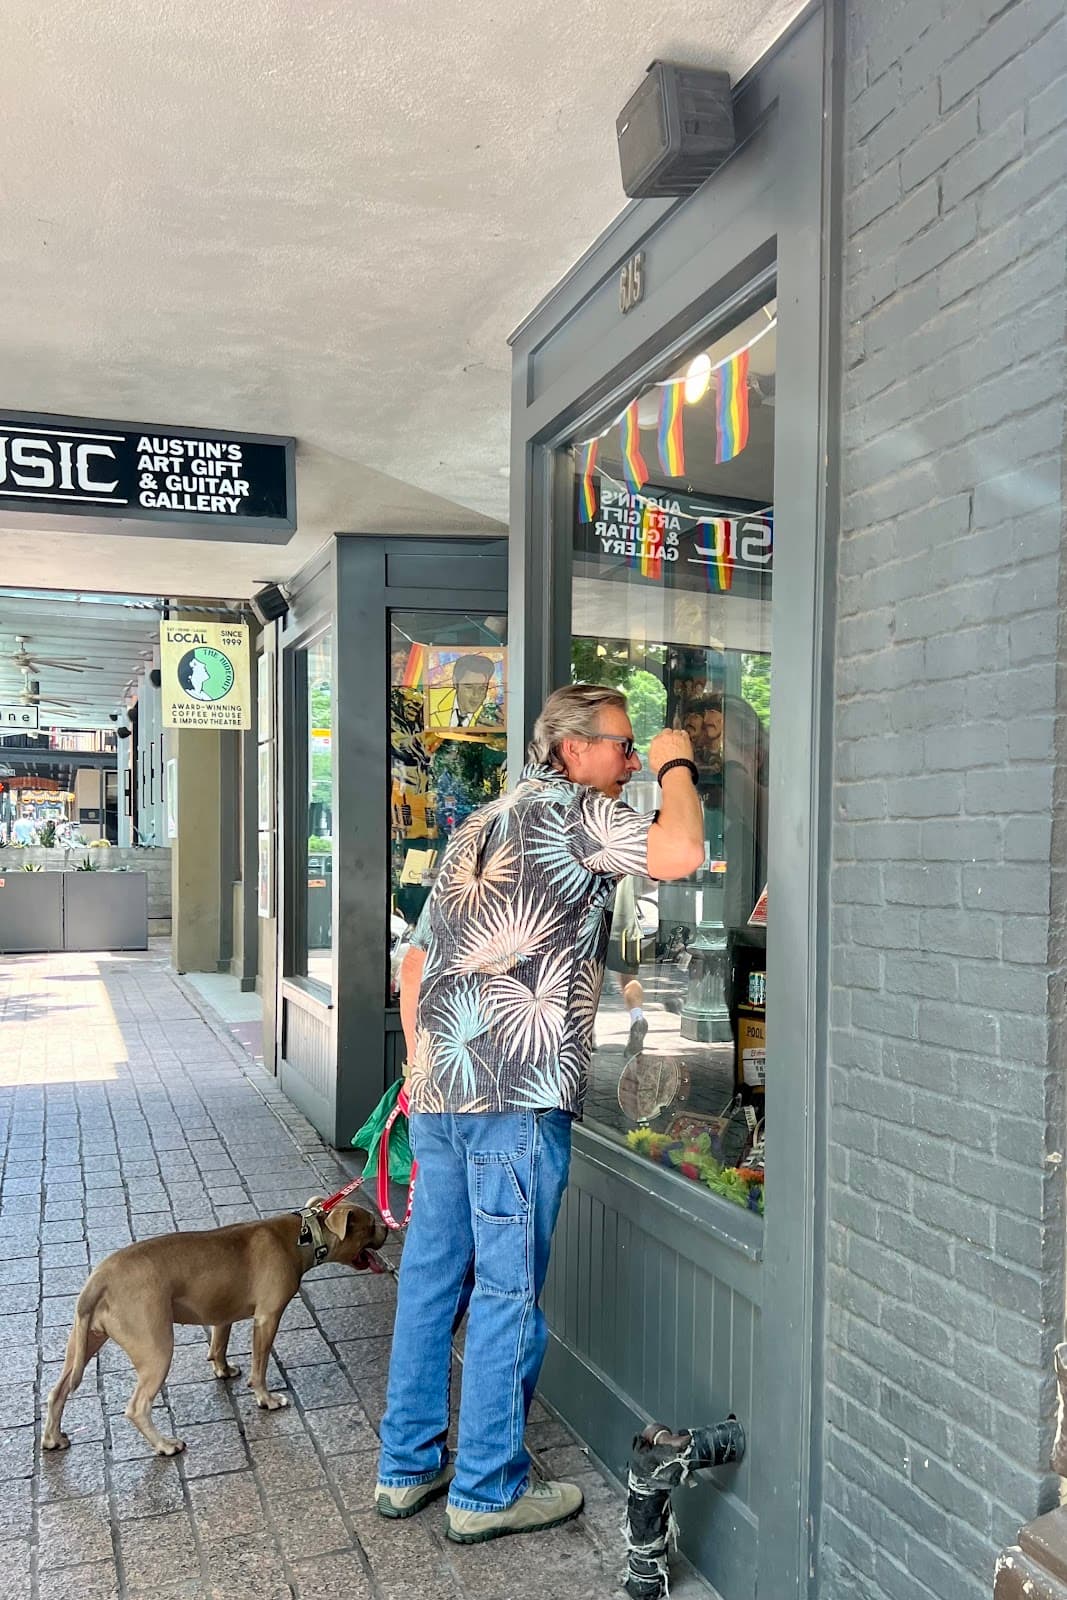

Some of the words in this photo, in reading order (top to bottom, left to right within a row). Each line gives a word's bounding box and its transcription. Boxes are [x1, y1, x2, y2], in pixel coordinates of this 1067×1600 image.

[136, 437, 242, 461] AUSTIN'S
[0, 436, 119, 493] SIC
[137, 455, 184, 476] ART
[191, 459, 242, 478] GIFT
[139, 473, 158, 490] &
[165, 474, 250, 497] GUITAR
[139, 491, 242, 514] GALLERY
[167, 632, 207, 644] LOCAL
[221, 630, 242, 638] SINCE
[223, 638, 242, 646] 1999
[0, 711, 30, 722] ne
[172, 704, 242, 712] AWARD-WINNING
[210, 718, 242, 726] THEATRE
